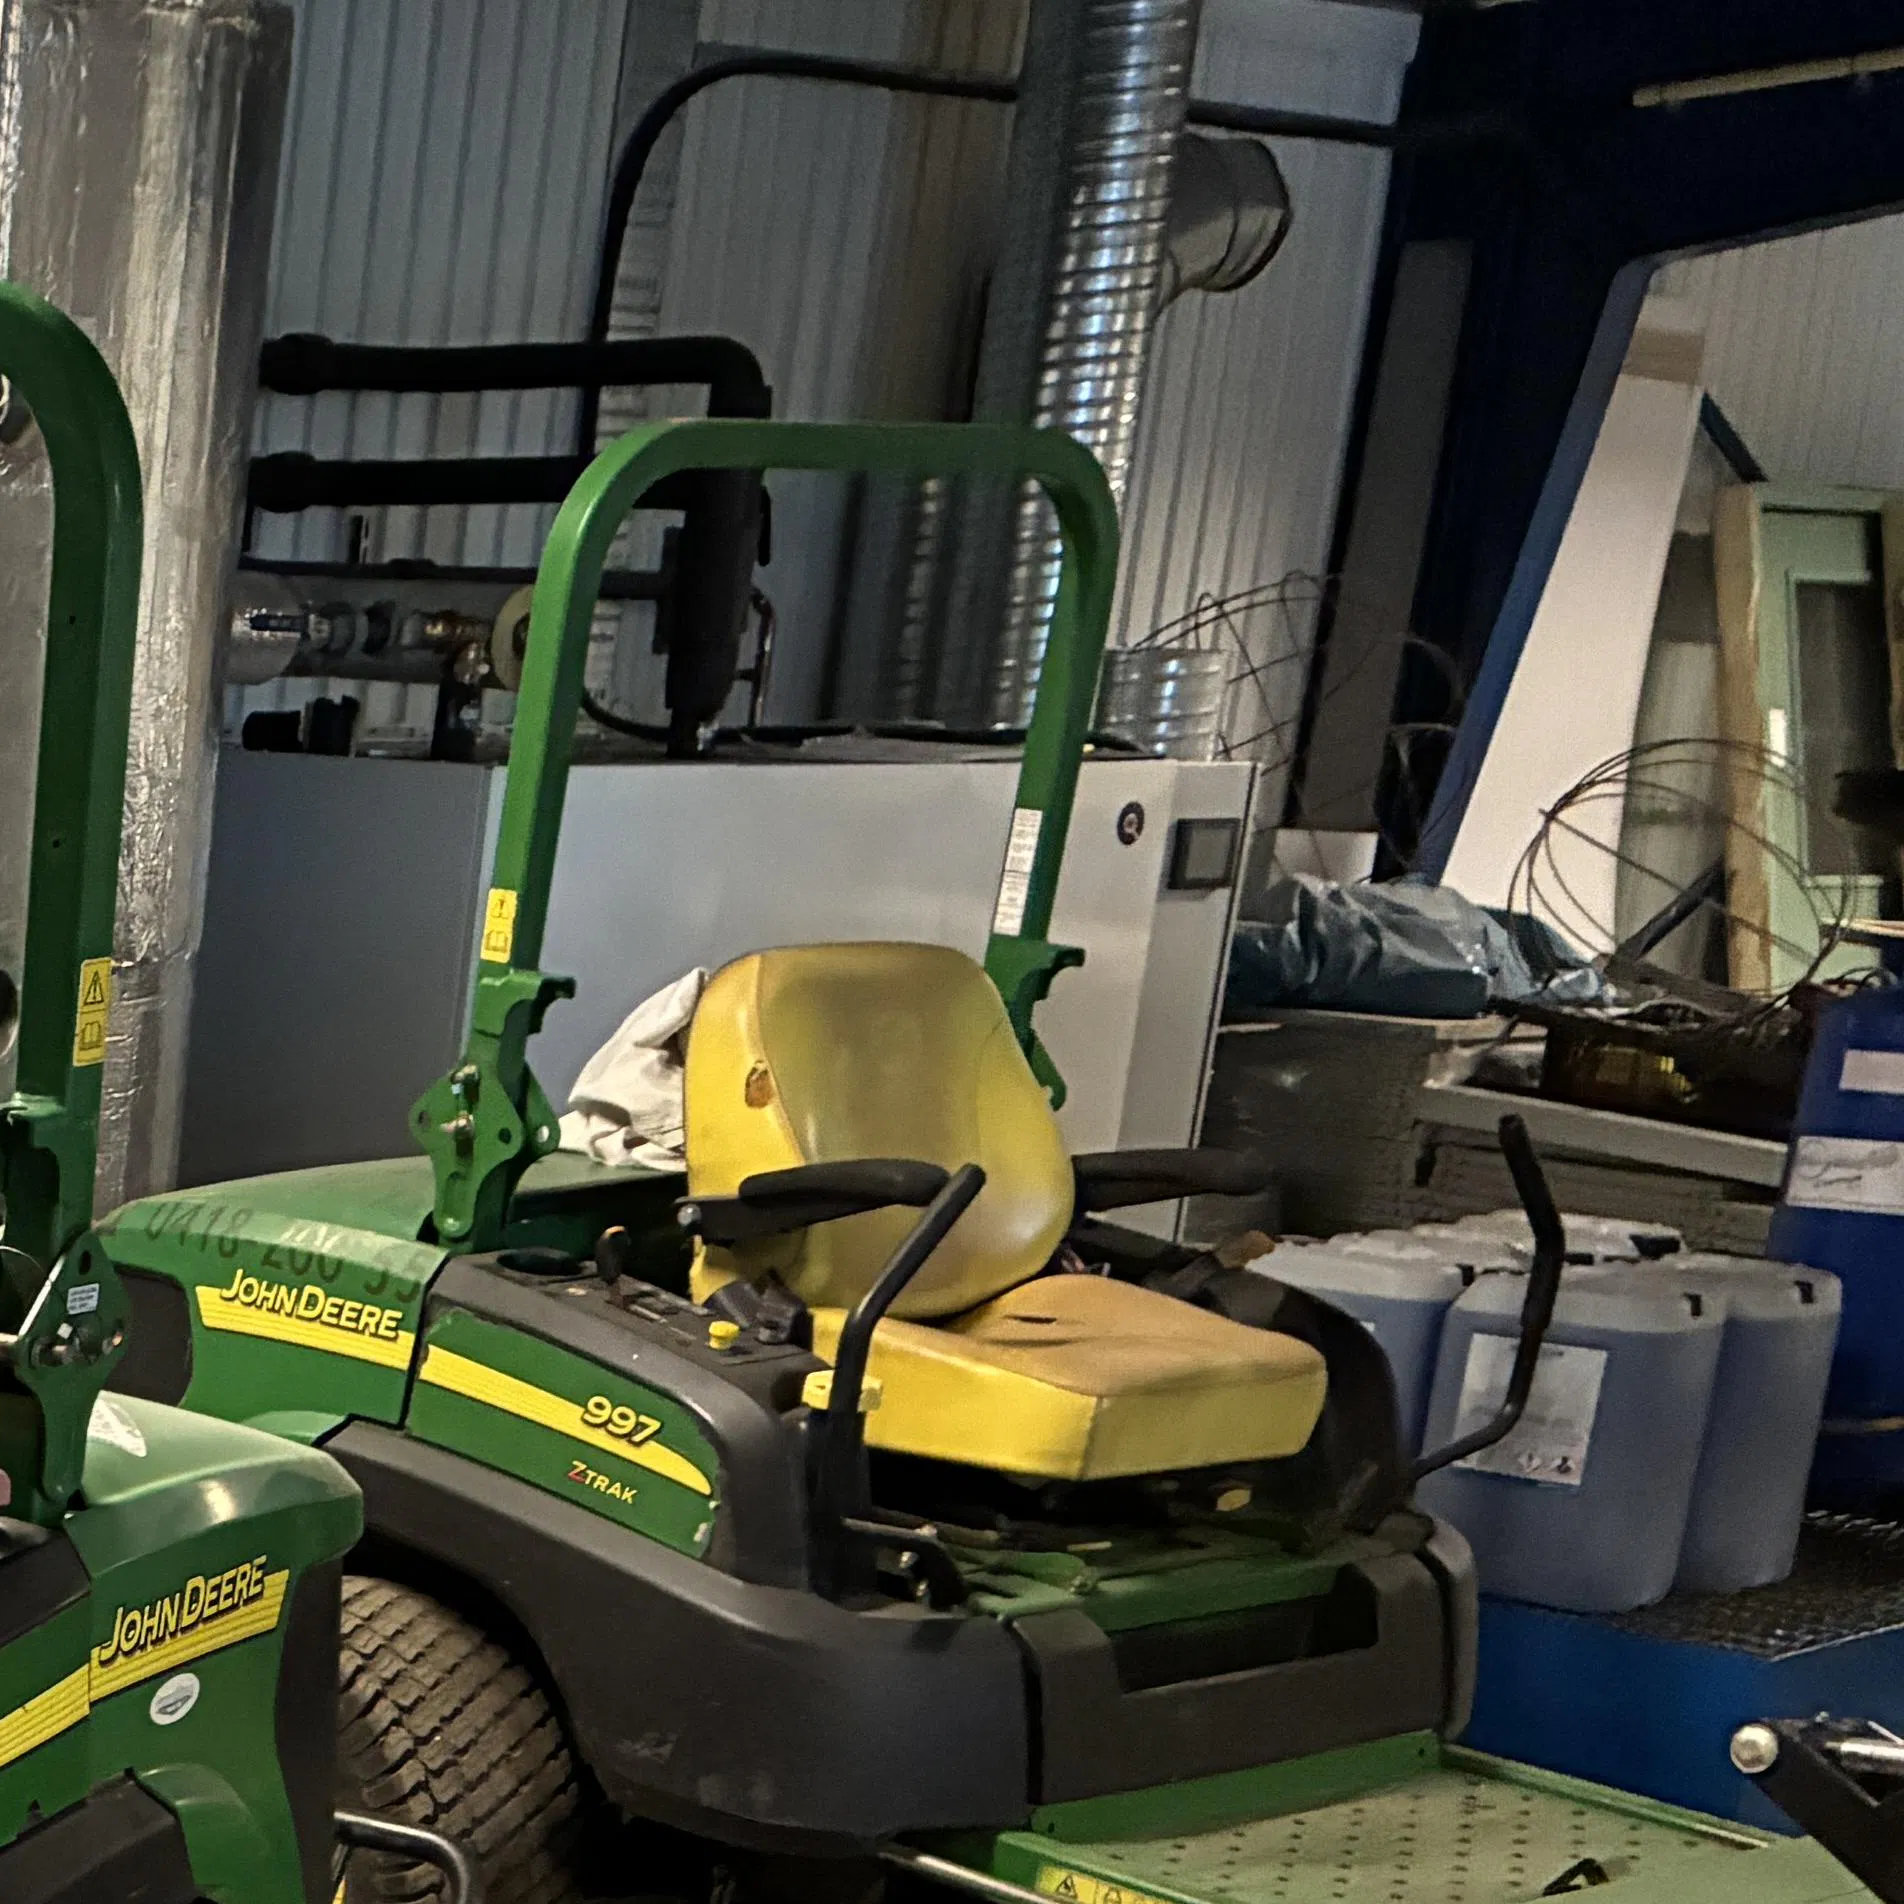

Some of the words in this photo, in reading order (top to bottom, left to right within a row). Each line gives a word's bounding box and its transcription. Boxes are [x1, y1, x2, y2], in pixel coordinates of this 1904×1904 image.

[220, 1269, 297, 1315] JOHN
[295, 1285, 403, 1338] DEERE
[582, 1395, 663, 1443] 997
[567, 1460, 640, 1505] ZTRAK
[98, 1592, 181, 1661] JOHN
[180, 1555, 267, 1629] DEERE
